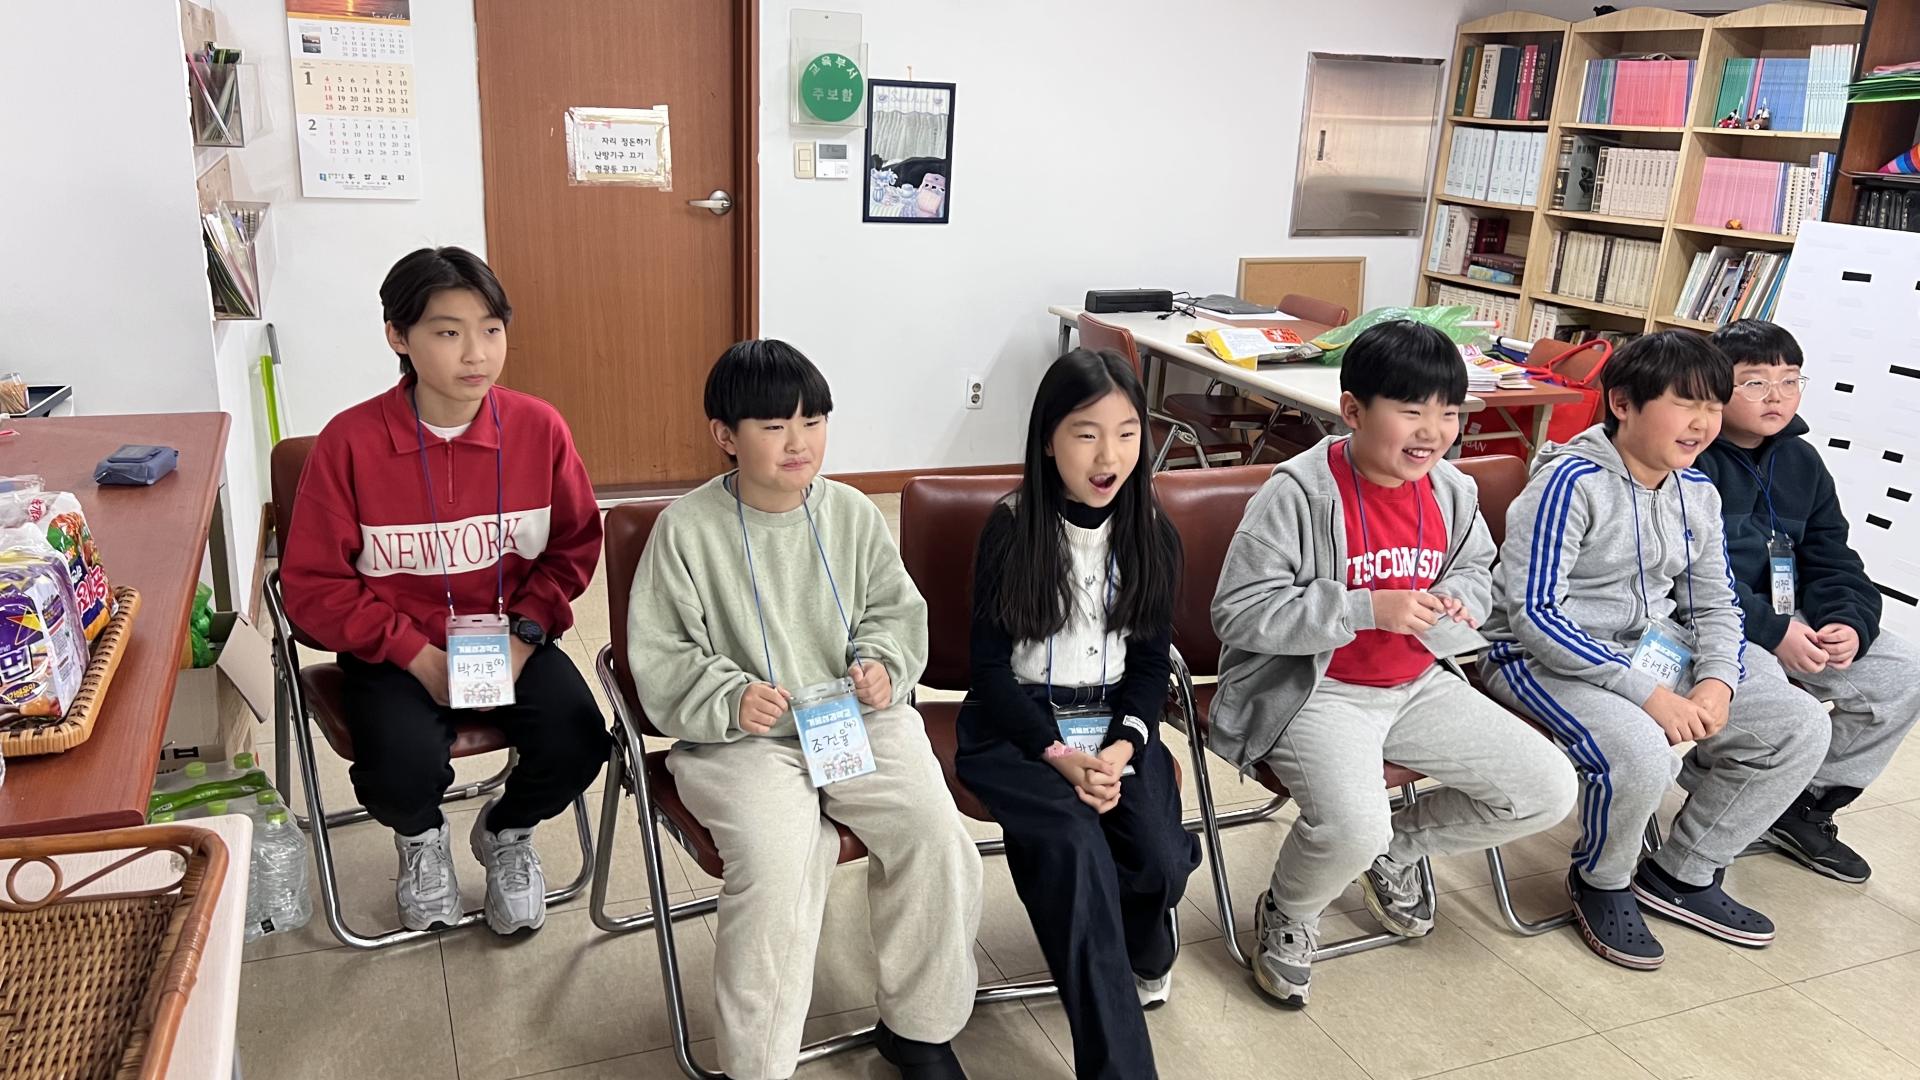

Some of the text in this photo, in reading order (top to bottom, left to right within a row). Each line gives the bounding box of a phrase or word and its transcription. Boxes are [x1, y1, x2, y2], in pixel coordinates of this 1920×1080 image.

[330, 27, 339, 36] 12
[808, 55, 858, 80] 교육부서
[305, 71, 312, 85] 1
[812, 87, 853, 103] 주보함
[308, 119, 317, 131] 2
[602, 137, 651, 147] 자리 정돈하기
[594, 151, 624, 160] 난방기구
[595, 165, 618, 174] 형광등
[1346, 546, 1443, 585] ISCONSI
